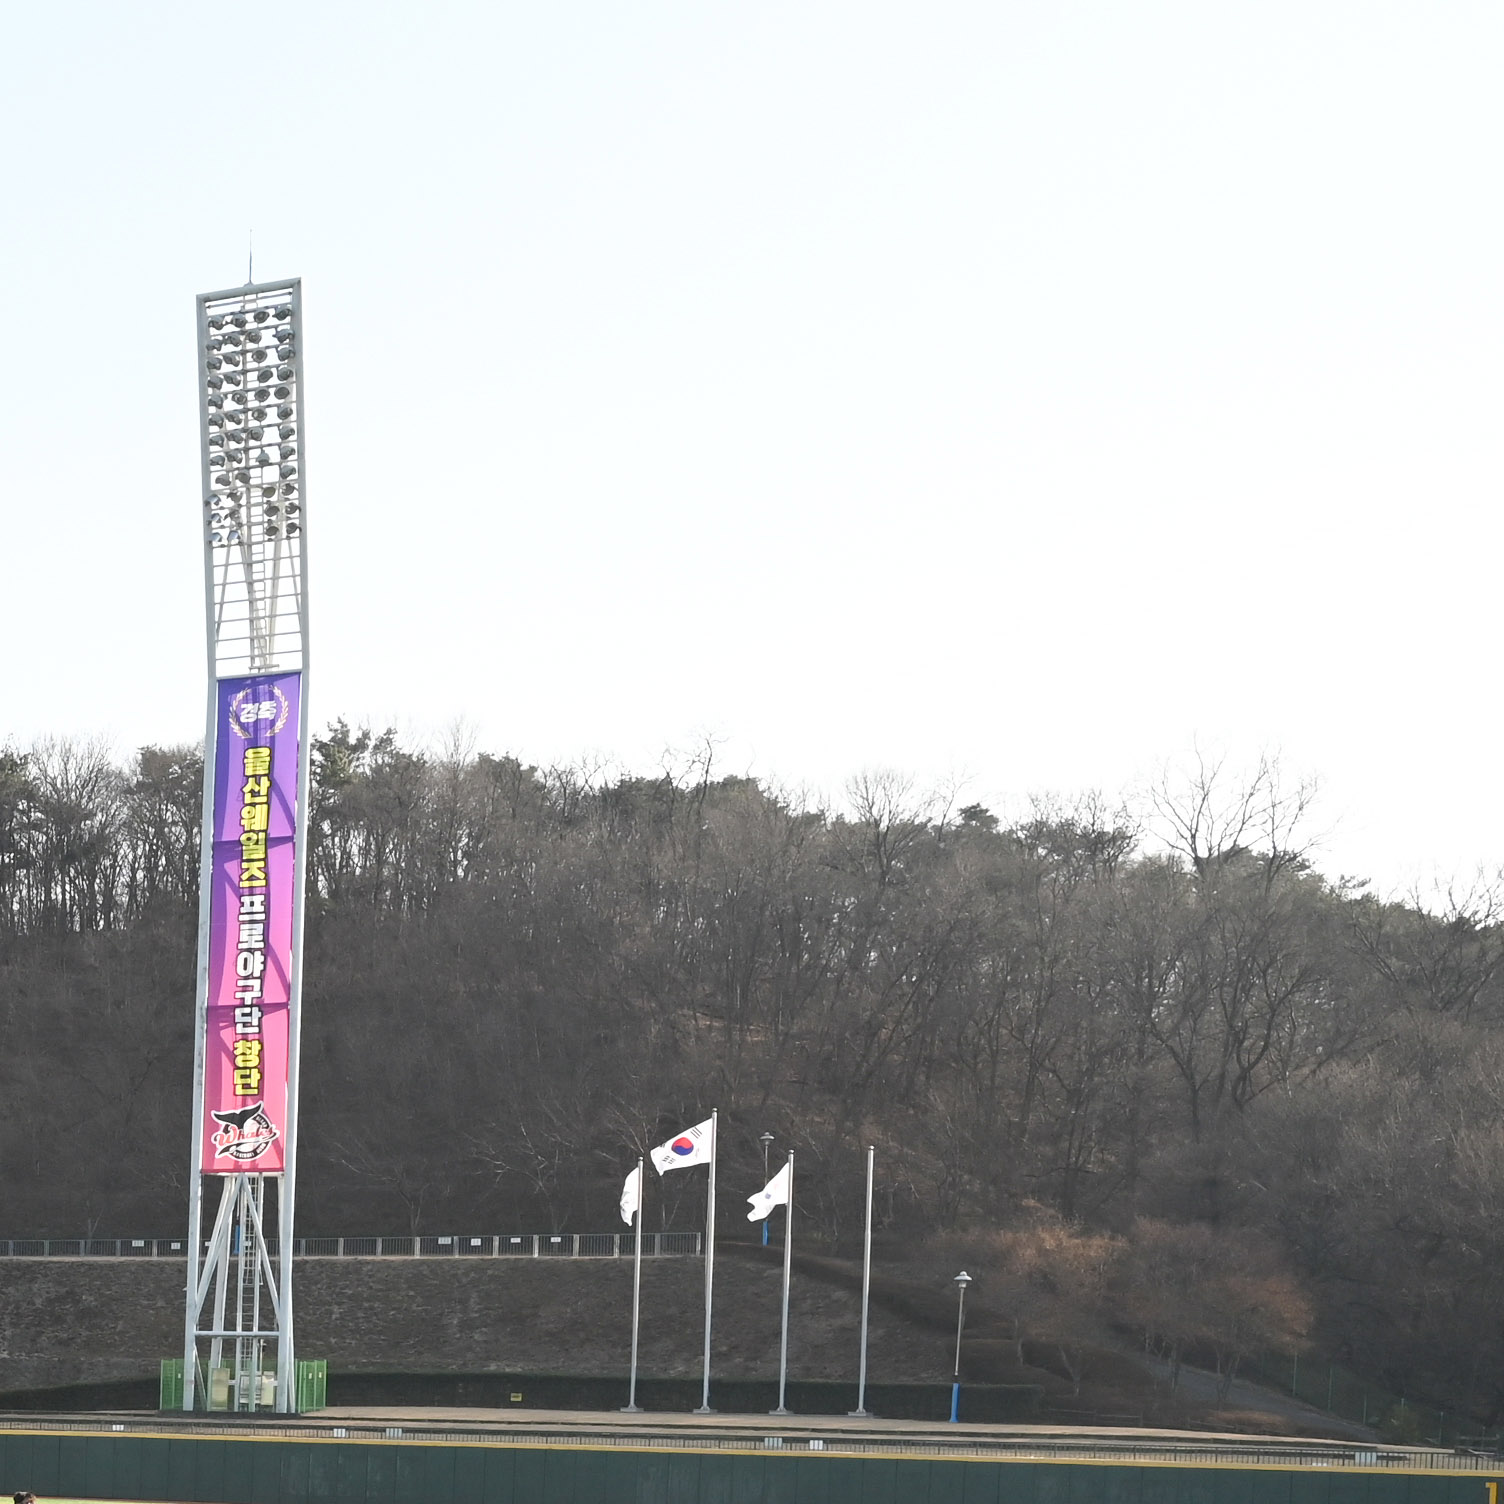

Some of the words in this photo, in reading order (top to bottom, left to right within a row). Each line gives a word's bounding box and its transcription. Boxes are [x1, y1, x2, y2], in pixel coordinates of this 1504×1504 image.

[240, 701, 276, 722] 경축
[239, 746, 271, 888] 울산웨일즈
[235, 895, 268, 1035] 프로야구단
[232, 1039, 263, 1096] 창단
[214, 1126, 273, 1146] Whales
